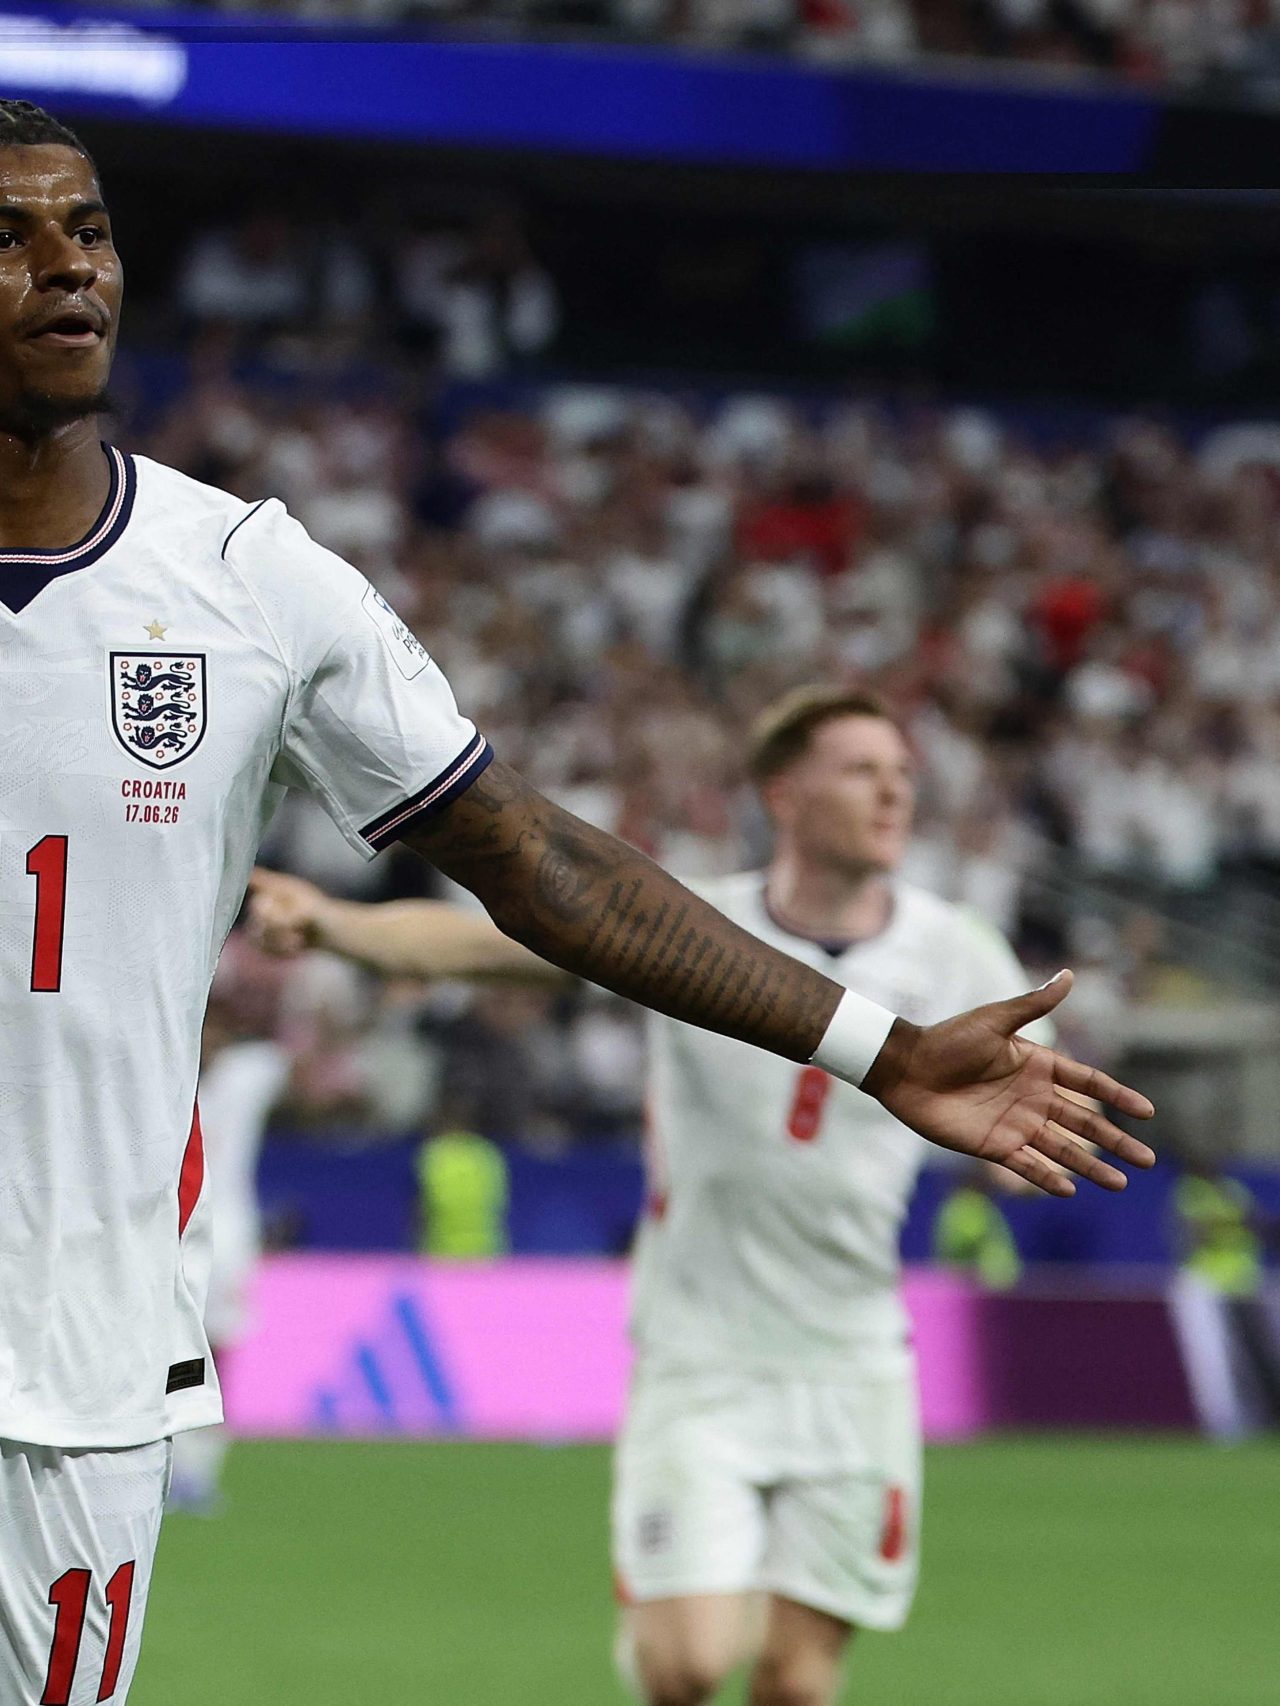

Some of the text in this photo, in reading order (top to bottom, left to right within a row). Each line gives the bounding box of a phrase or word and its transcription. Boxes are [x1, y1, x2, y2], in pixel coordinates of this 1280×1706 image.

[121, 779, 186, 800] CROATIA
[125, 804, 179, 824] 17.06.26
[39, 1559, 136, 1706] 11
